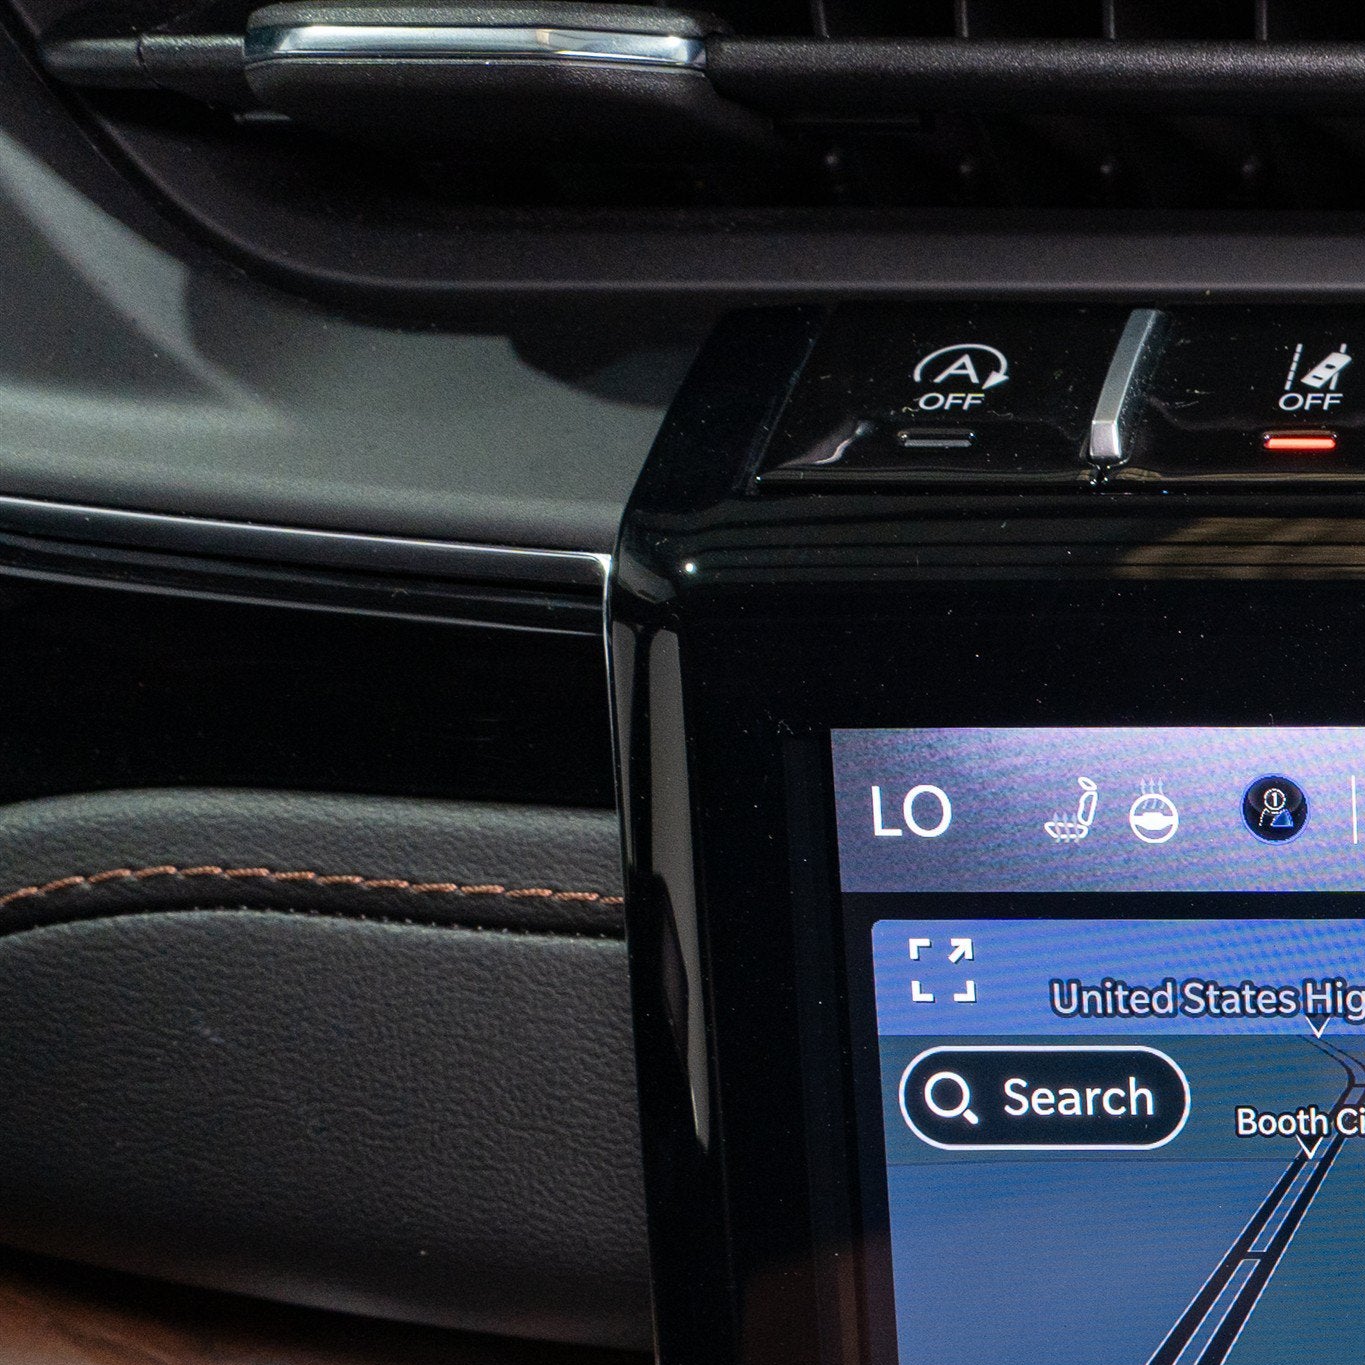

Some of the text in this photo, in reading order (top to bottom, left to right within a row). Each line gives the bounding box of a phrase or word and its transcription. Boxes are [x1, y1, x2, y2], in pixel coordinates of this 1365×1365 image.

[918, 391, 985, 411] OFF
[1279, 392, 1343, 411] OFF
[872, 785, 953, 838] LO
[1052, 981, 1176, 1016] United
[1183, 981, 1296, 1016] States
[1003, 1077, 1154, 1117] Search
[1237, 1108, 1331, 1138] Booth
